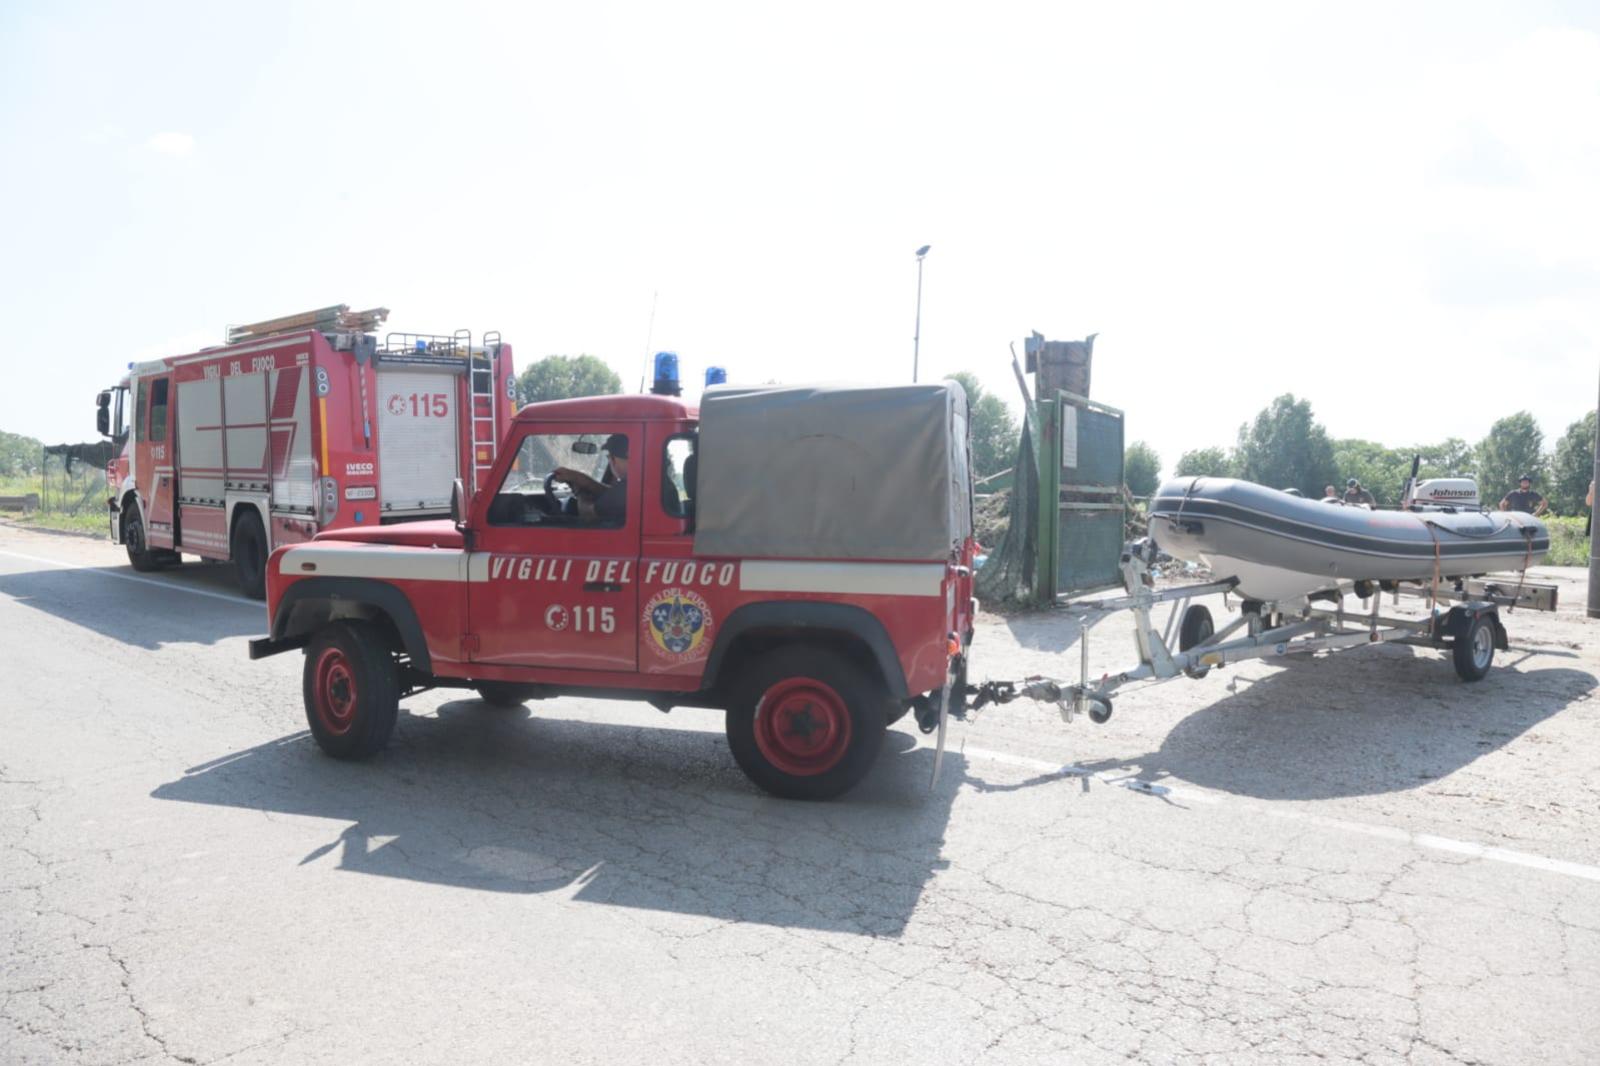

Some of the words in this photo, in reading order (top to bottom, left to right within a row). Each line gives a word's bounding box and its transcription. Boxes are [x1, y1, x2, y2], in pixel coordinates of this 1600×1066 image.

[252, 354, 275, 372] FUOCO
[409, 393, 448, 417] 115
[346, 463, 373, 471] IVECO
[1429, 488, 1476, 497] Johnson
[491, 557, 573, 581] VIGILI
[585, 560, 632, 584] DEL
[645, 561, 736, 587] FUOCO
[662, 587, 682, 598] DEL
[686, 590, 713, 626] FUOCO
[573, 605, 615, 633] 115
